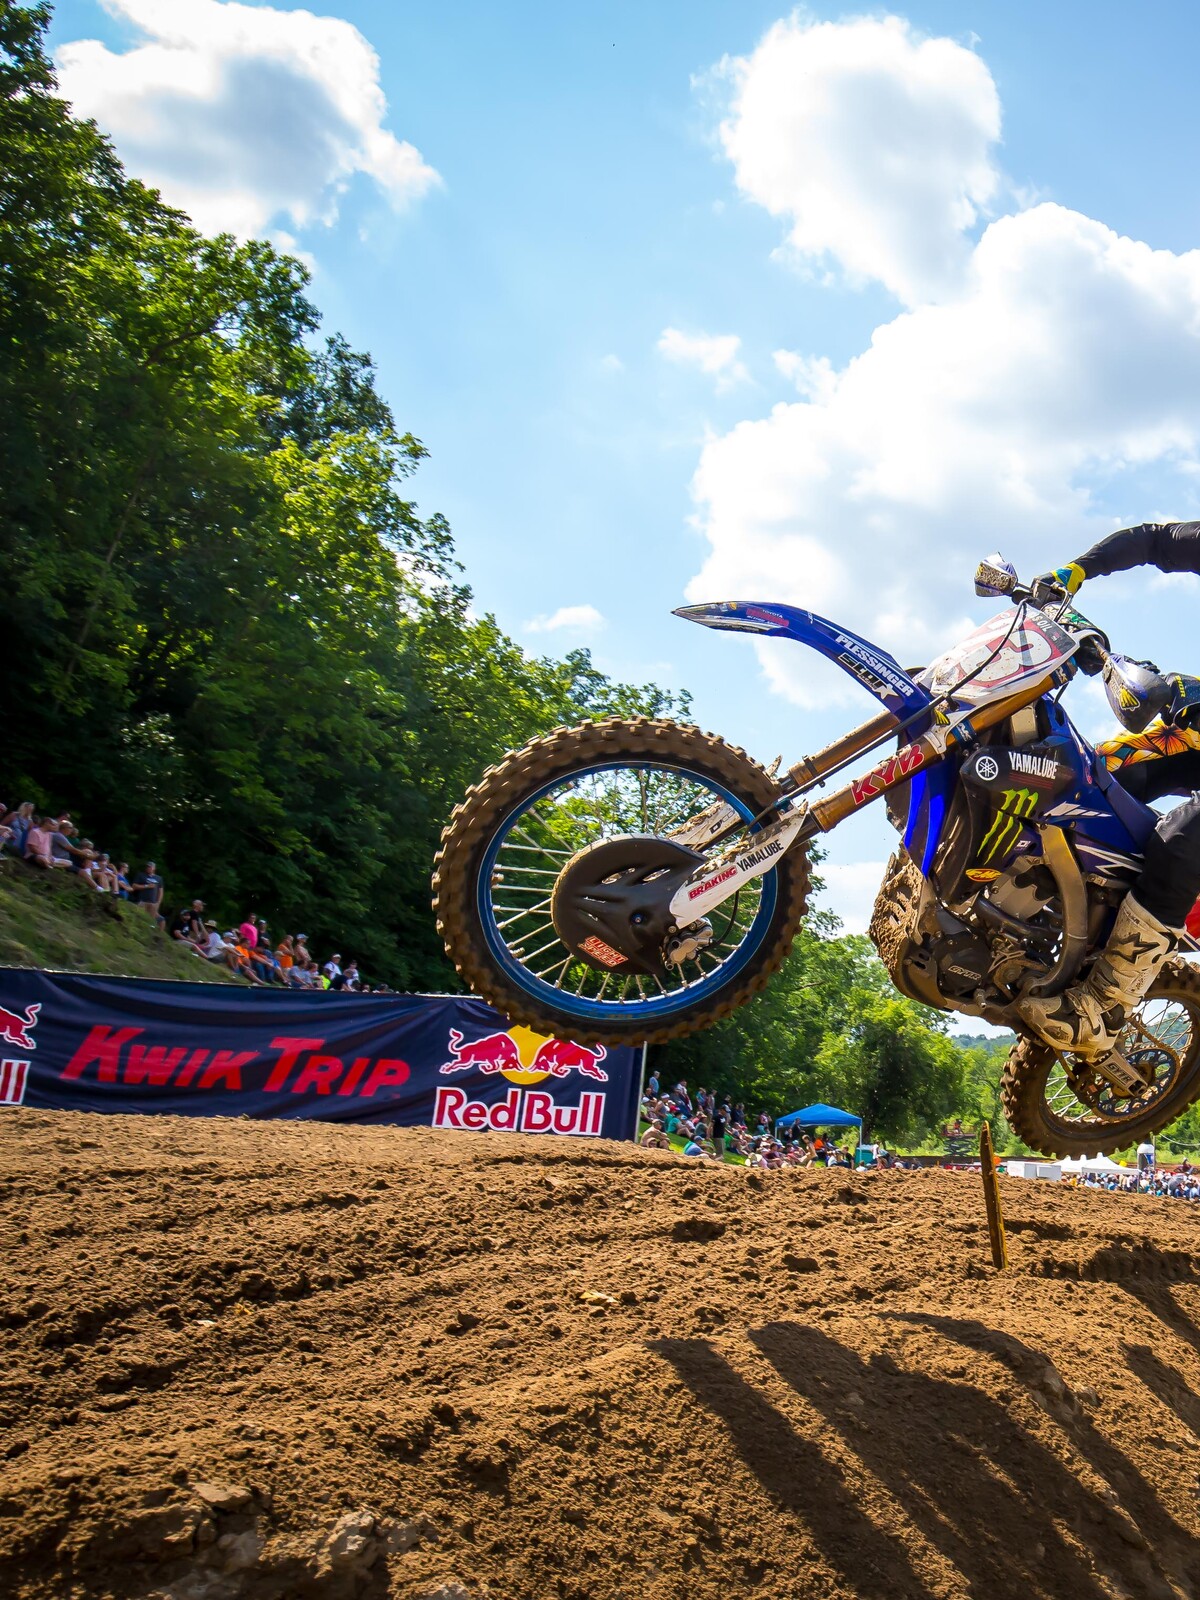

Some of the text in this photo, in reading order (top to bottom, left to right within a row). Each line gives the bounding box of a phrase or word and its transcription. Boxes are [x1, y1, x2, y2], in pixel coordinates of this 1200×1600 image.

[835, 634, 914, 697] PLESSINGER
[851, 744, 925, 805] KYB
[1008, 752, 1059, 780] YAMALUBE
[737, 839, 784, 872] YAMALUBE
[688, 866, 738, 901] BRAKING
[1106, 1062, 1135, 1084] GYTR
[432, 1086, 606, 1136] Red Bull
